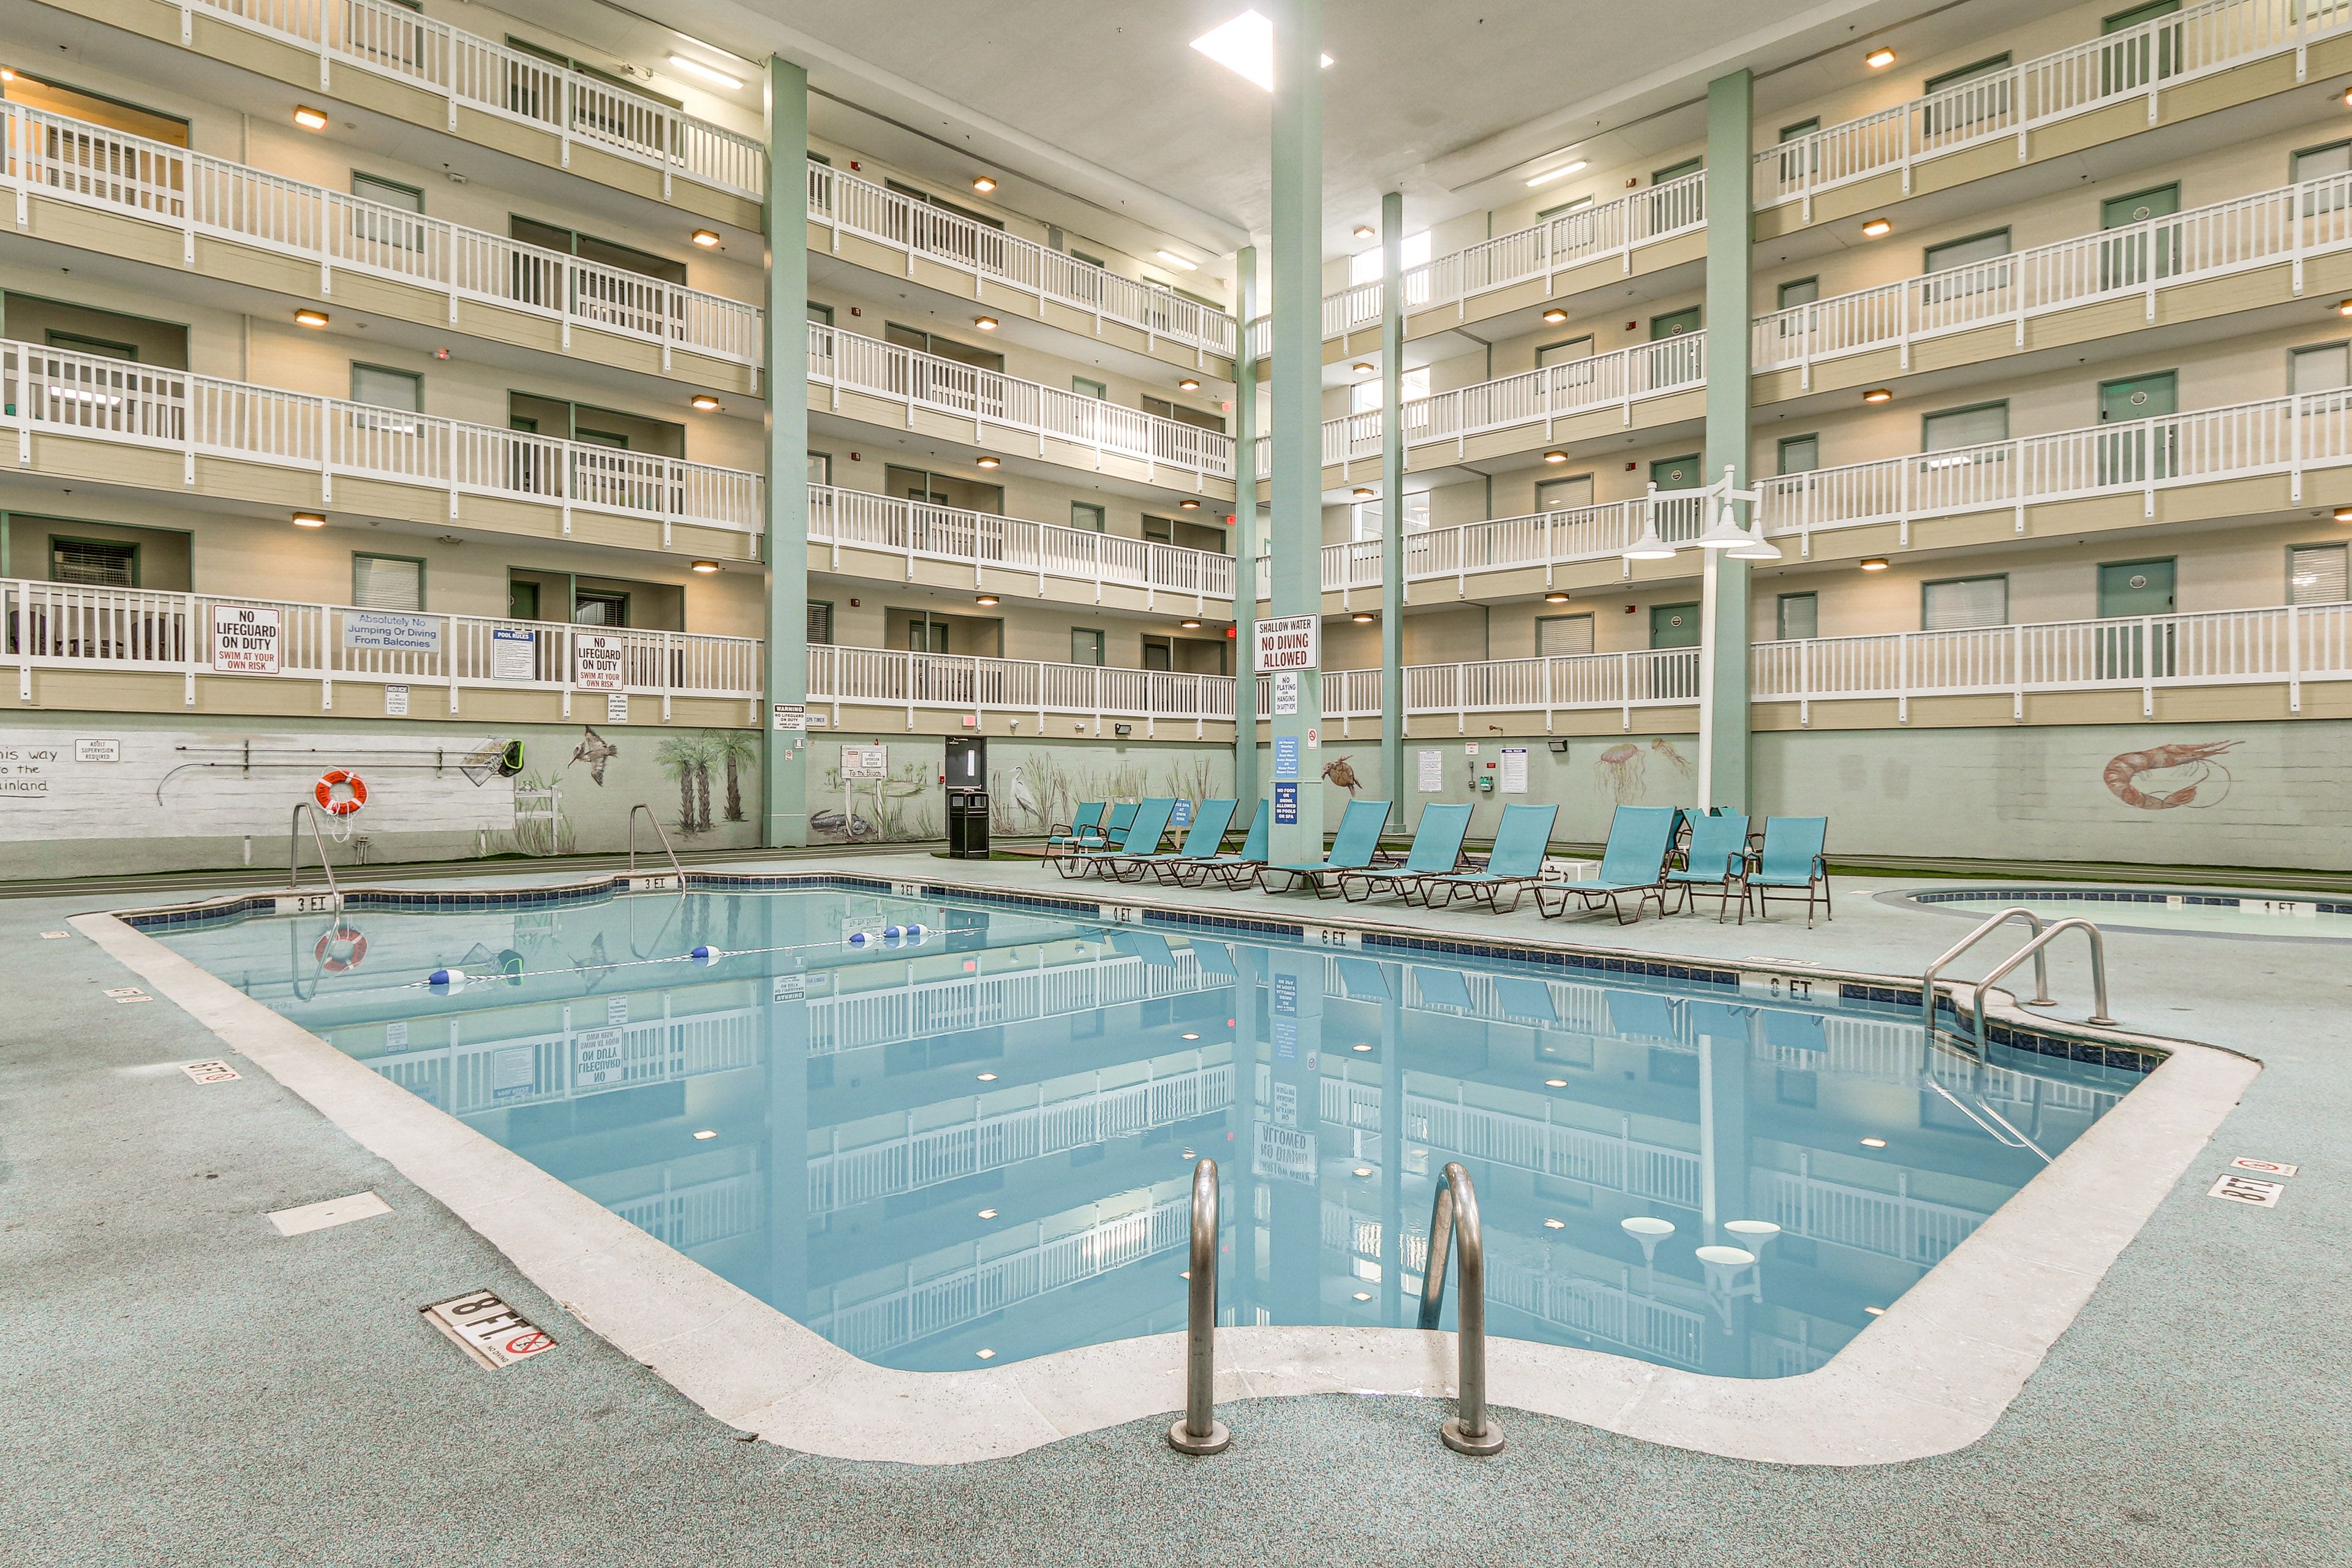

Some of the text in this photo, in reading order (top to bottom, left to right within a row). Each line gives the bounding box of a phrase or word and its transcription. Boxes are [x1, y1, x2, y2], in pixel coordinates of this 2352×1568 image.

[239, 611, 254, 622] NO
[359, 614, 409, 627] Absolutely
[217, 622, 276, 637] LIFEGUARD
[348, 625, 391, 636] Jumping
[408, 628, 436, 639] Diving
[1259, 619, 1311, 633] SHALLOW WATER
[222, 636, 271, 650] ON DUTY
[383, 637, 430, 647] Balconies
[594, 638, 605, 647] NO
[1262, 633, 1308, 651] NO DIVING
[219, 651, 241, 660] SWIM
[254, 653, 274, 662] YOUR
[579, 648, 620, 660] LIFEGUARD
[1264, 650, 1307, 668] ALLOWED
[582, 660, 617, 671] ON DUTY
[28, 750, 58, 762] way
[17, 765, 40, 774] the
[488, 760, 503, 772] BEAC
[0, 780, 49, 791] inland
[2220, 1189, 2266, 1201] 8
[451, 1297, 502, 1315] 8
[494, 1350, 510, 1363] DIVING
